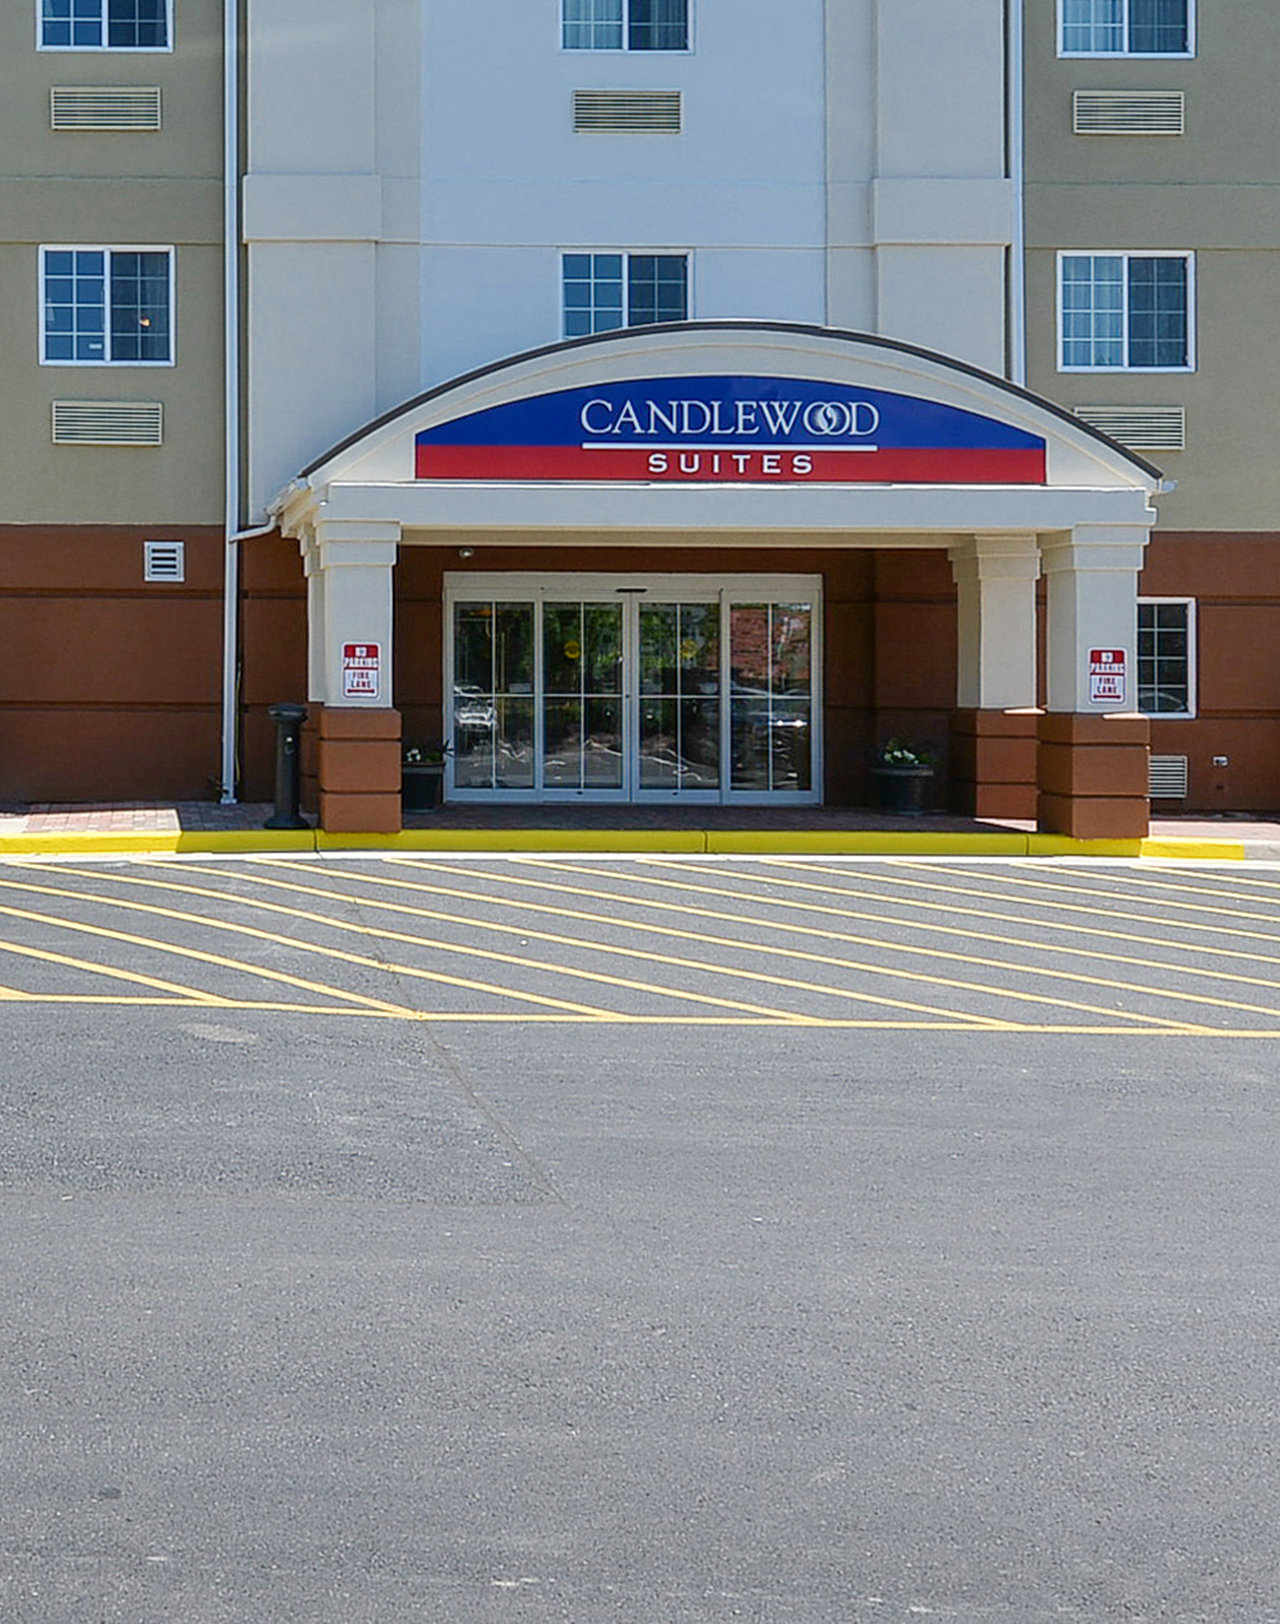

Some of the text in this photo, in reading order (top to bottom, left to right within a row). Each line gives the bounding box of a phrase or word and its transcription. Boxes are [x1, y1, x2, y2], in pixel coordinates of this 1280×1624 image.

[580, 399, 879, 436] CANDLEWOOD
[648, 453, 813, 474] SUITES
[352, 671, 369, 679] FIRE
[351, 680, 370, 688] LANE
[1098, 677, 1115, 685] FIRE
[1097, 686, 1116, 694] LANE
